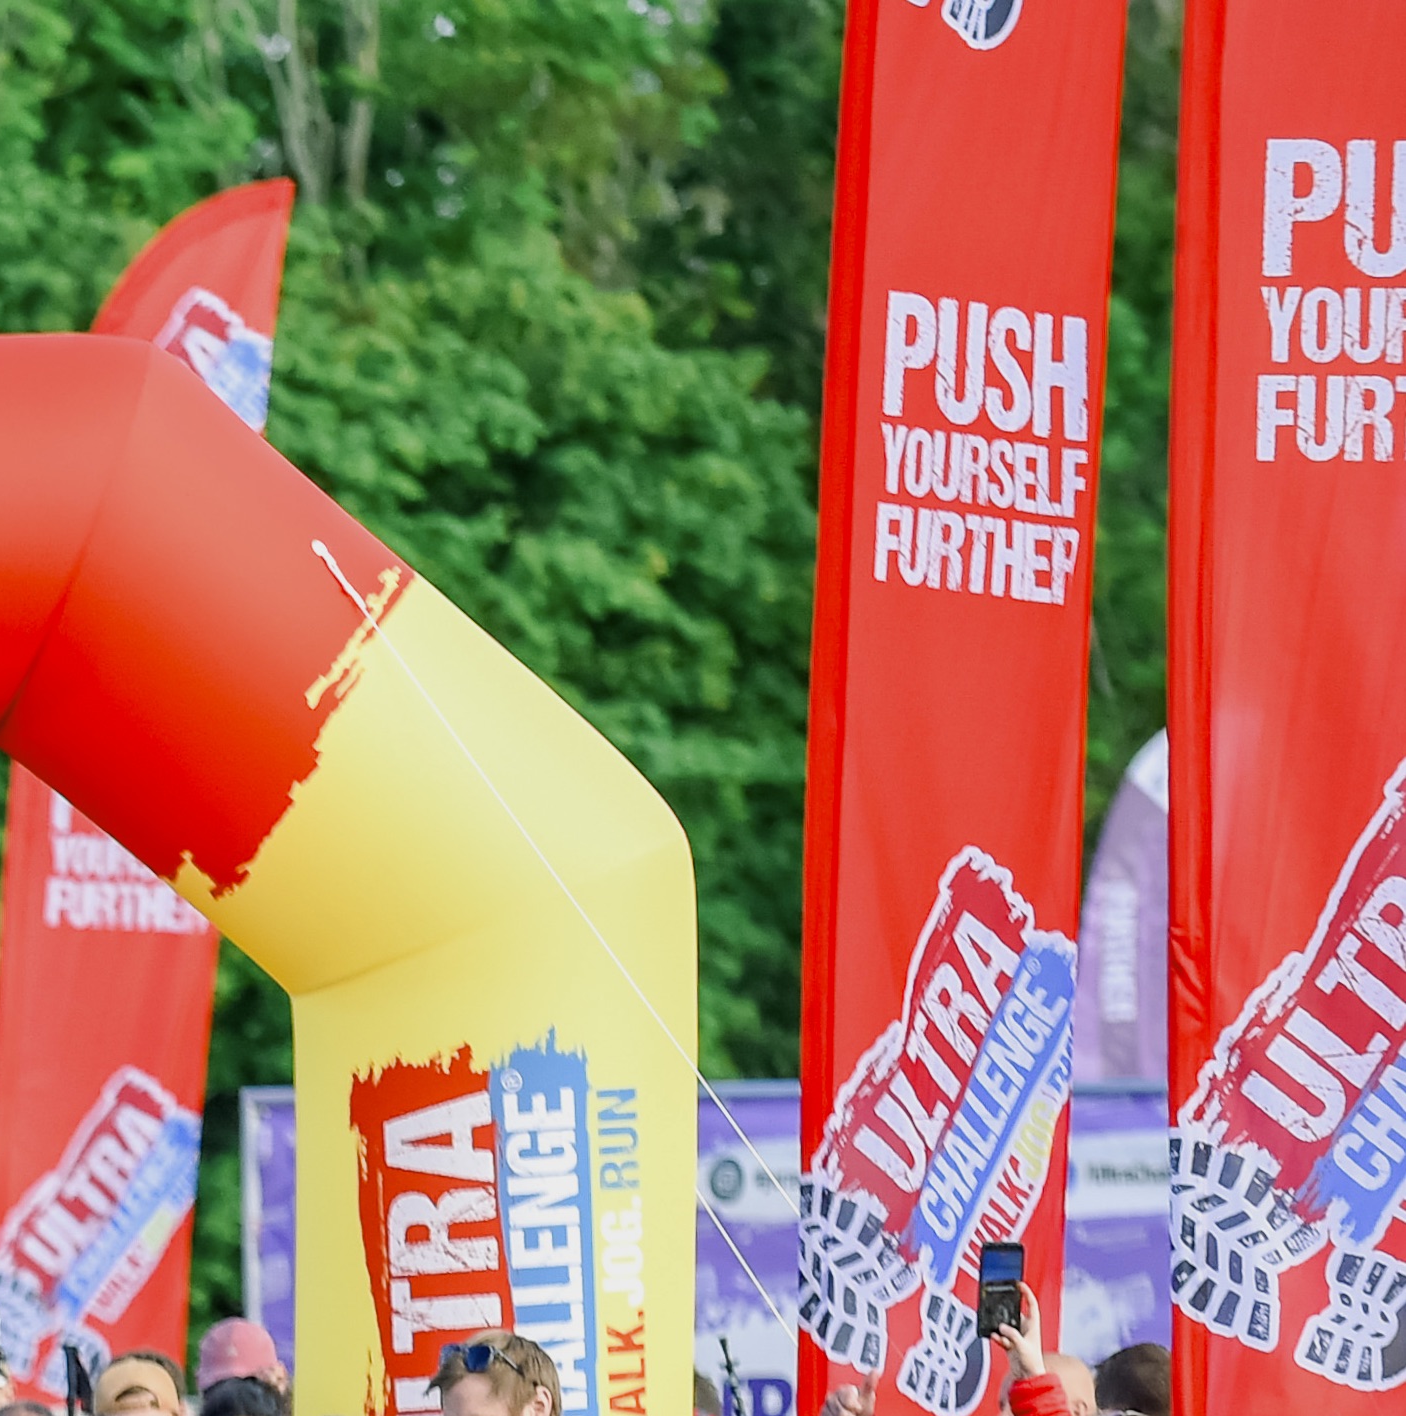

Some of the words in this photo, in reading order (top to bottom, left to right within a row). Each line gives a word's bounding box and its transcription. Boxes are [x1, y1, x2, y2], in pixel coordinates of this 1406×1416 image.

[882, 289, 1088, 442] PUSH
[1255, 374, 1406, 462] FUR
[880, 421, 1089, 518] YOURSELF
[852, 911, 1022, 1195] ULTRA
[919, 982, 1069, 1244] CHALLENGE
[1048, 1022, 1074, 1094] RU
[21, 1102, 163, 1276] ULTRA
[596, 1087, 640, 1192] RUN
